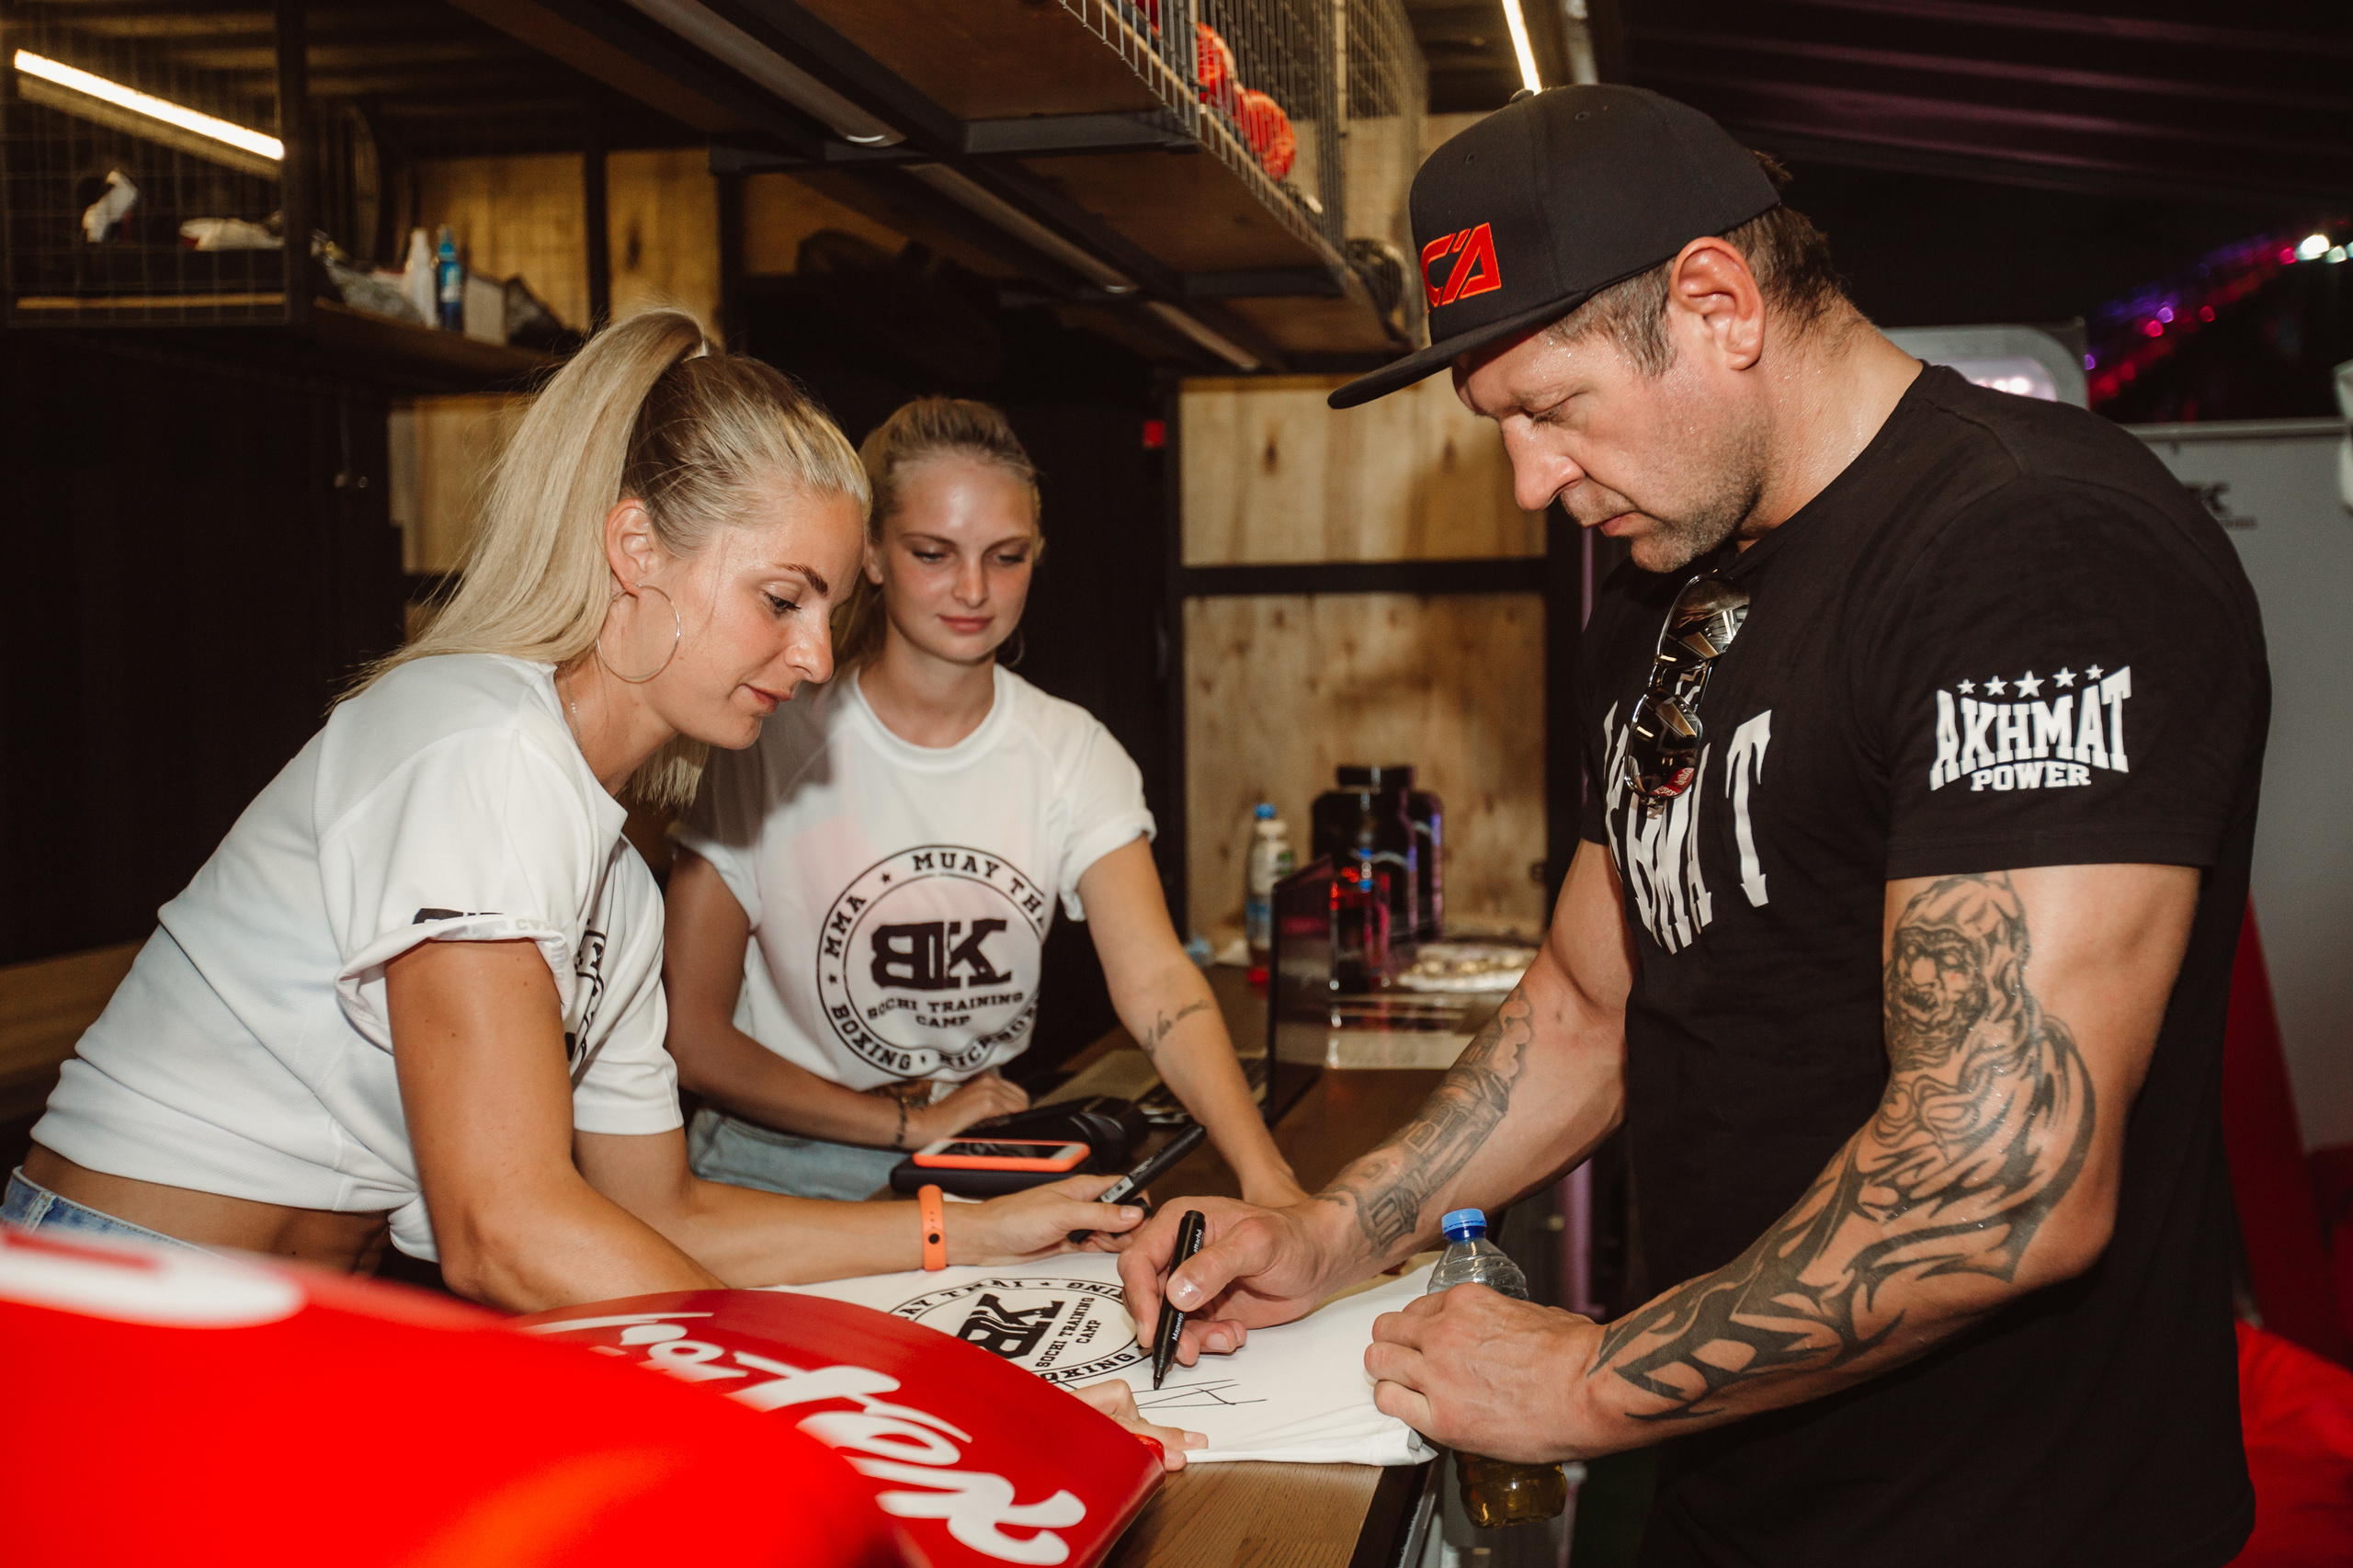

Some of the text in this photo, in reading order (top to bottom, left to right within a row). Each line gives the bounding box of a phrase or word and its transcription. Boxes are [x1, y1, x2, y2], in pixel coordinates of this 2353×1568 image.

[1930, 665, 2131, 791] AKHMAT
[1971, 760, 2092, 791] POWER
[913, 852, 1000, 879] MUAY
[824, 895, 867, 960] MMA
[927, 992, 1024, 1013] TRAINING
[915, 1015, 972, 1028] CAMP
[831, 1003, 912, 1071] BOXING
[1035, 1340, 1068, 1368] SOCHI
[1058, 1296, 1096, 1337] TRAINING
[1075, 1319, 1101, 1344] CAMP
[1172, 1312, 1184, 1342] Маркер
[1040, 1353, 1136, 1382] OXING
